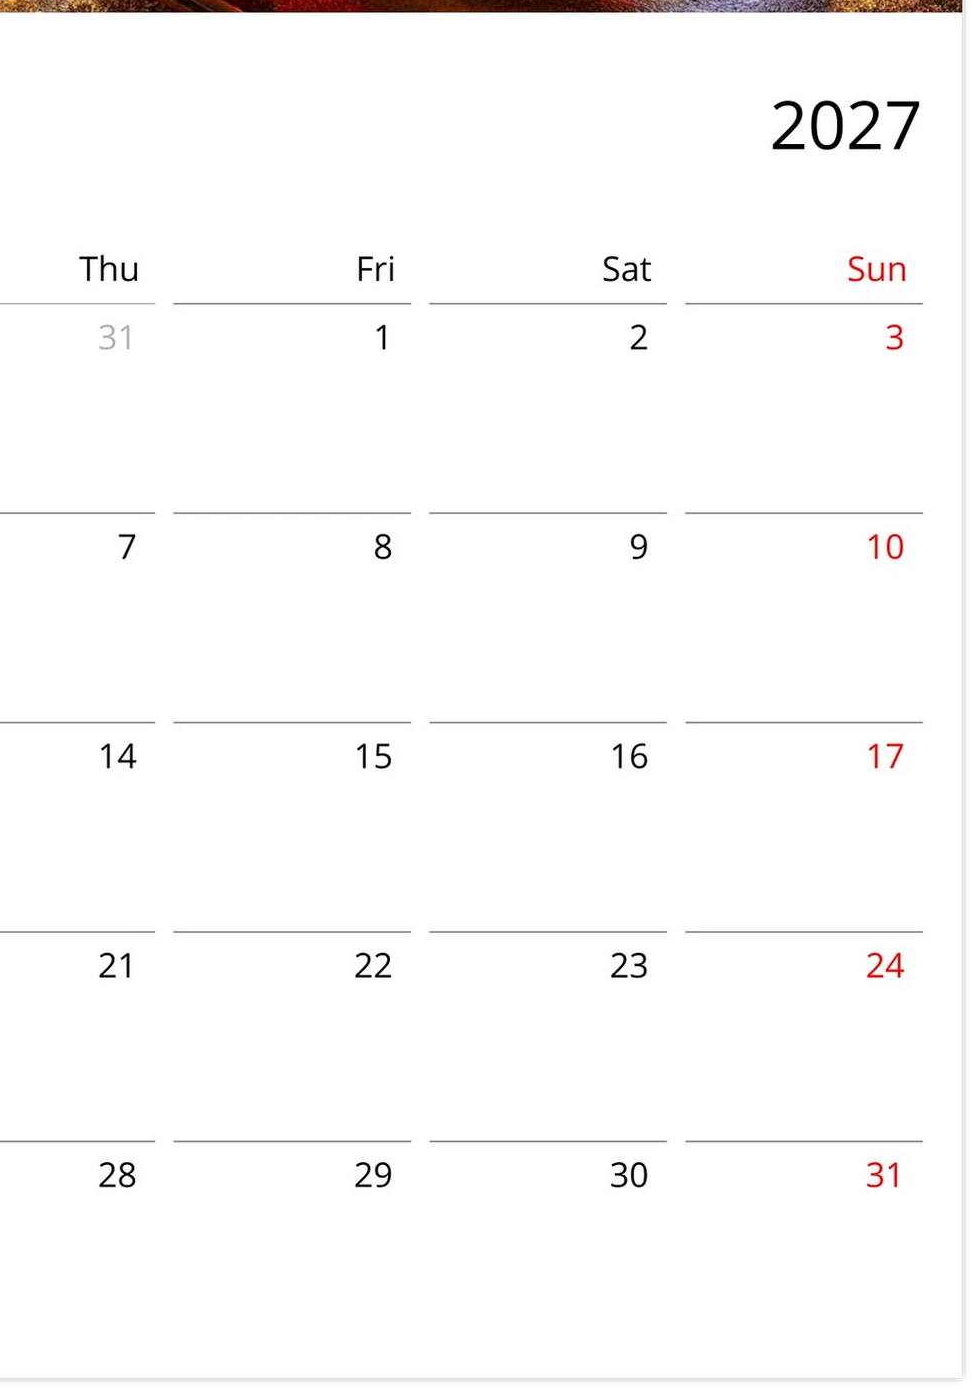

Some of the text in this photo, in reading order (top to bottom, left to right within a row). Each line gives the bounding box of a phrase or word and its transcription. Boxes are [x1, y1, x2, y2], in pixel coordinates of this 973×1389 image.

[771, 99, 921, 151] 2027
[78, 253, 138, 283] Thu
[358, 254, 395, 282] Fri
[602, 255, 653, 283] Sat
[847, 255, 907, 283] Sun
[98, 324, 130, 351] 31
[375, 323, 387, 351] 1
[629, 323, 649, 351] 2
[885, 323, 904, 351] 3
[117, 533, 137, 560] 7
[374, 533, 393, 561] 8
[630, 533, 648, 561] 9
[867, 532, 905, 561] 10
[100, 742, 138, 770] 14
[356, 742, 392, 770] 15
[612, 742, 649, 770] 16
[868, 742, 905, 770] 17
[98, 951, 131, 979] 21
[354, 951, 393, 979] 22
[610, 951, 648, 979] 23
[866, 951, 906, 979] 24
[98, 1161, 137, 1189] 28
[354, 1161, 392, 1189] 29
[610, 1161, 649, 1189] 30
[866, 1161, 899, 1189] 31
